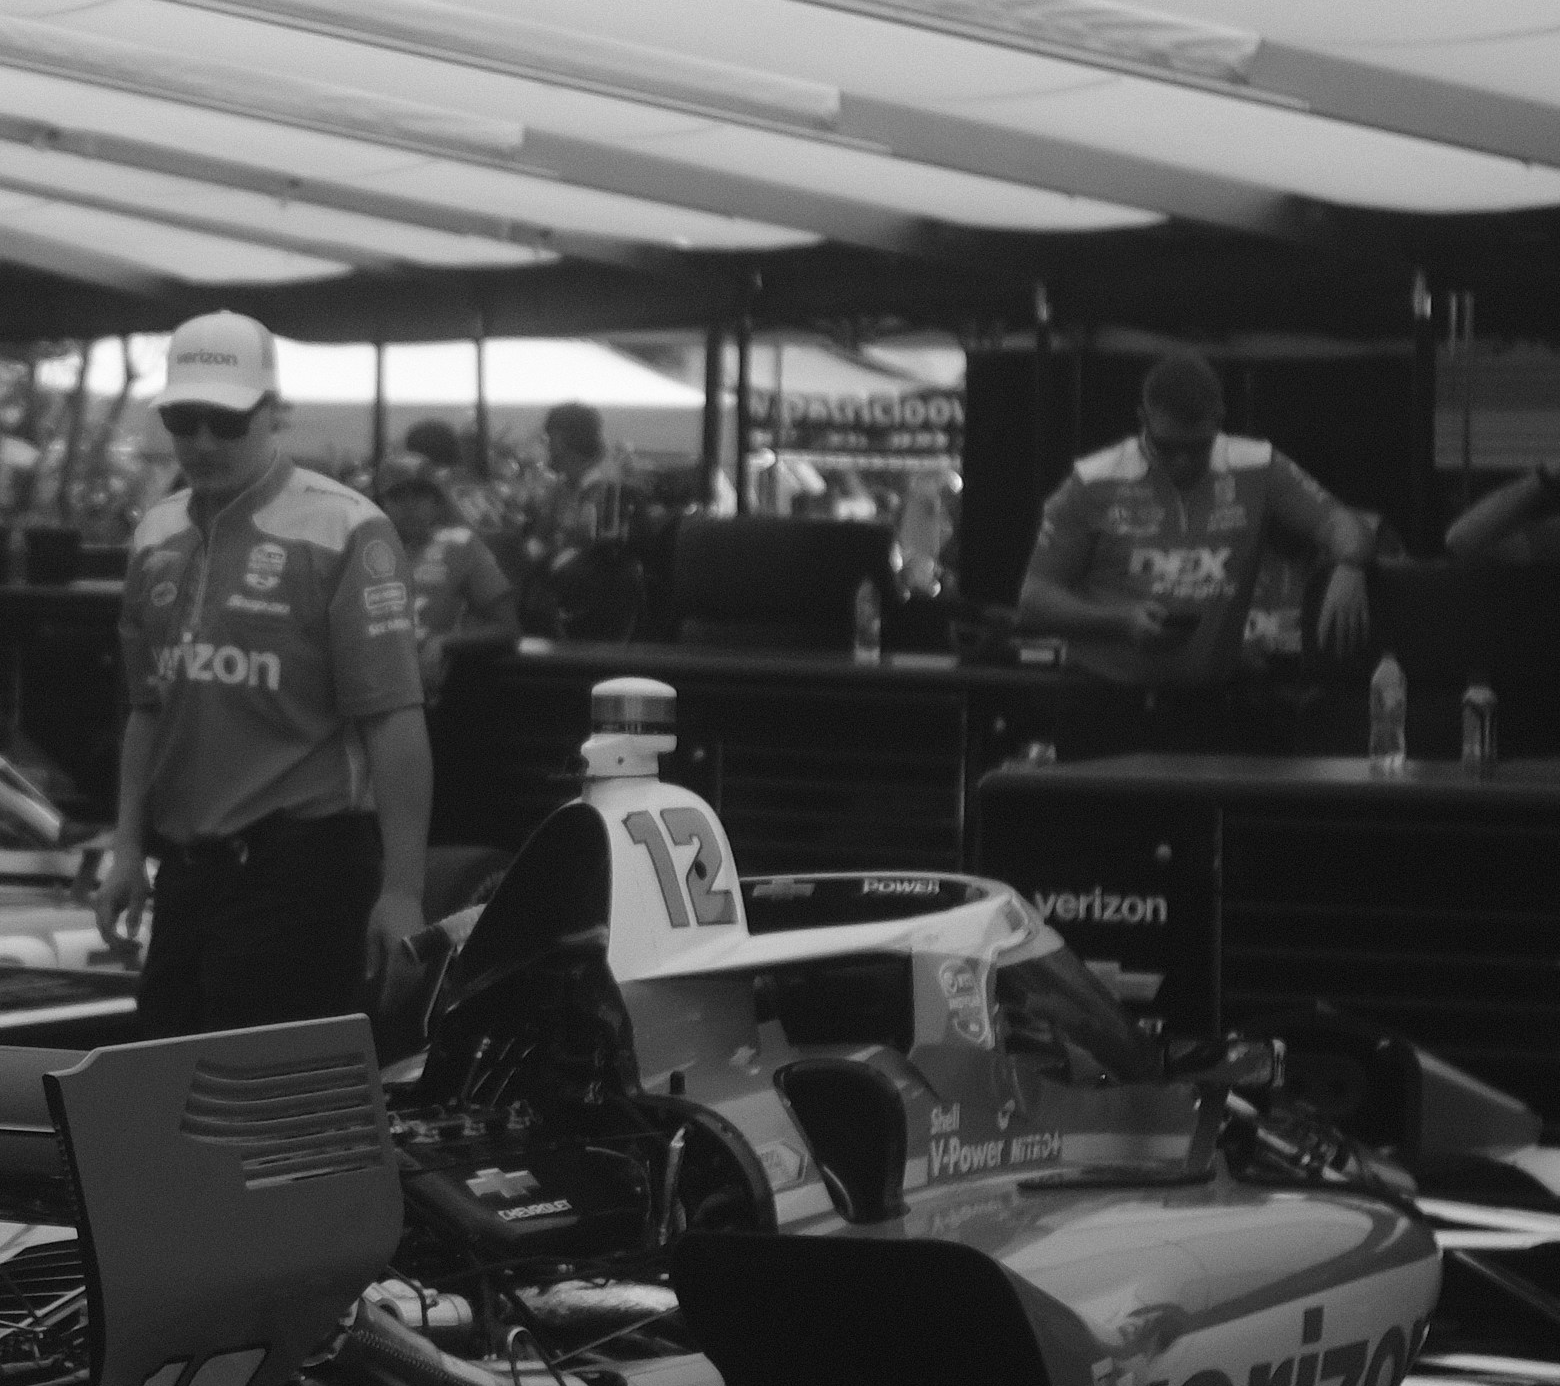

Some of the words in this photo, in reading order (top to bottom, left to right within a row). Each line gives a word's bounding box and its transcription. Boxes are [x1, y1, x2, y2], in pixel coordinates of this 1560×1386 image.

[177, 348, 238, 366] verizon
[621, 806, 737, 929] 12
[861, 878, 941, 895] POWER
[1034, 883, 1169, 925] verizon
[931, 1135, 1005, 1177] V-Power
